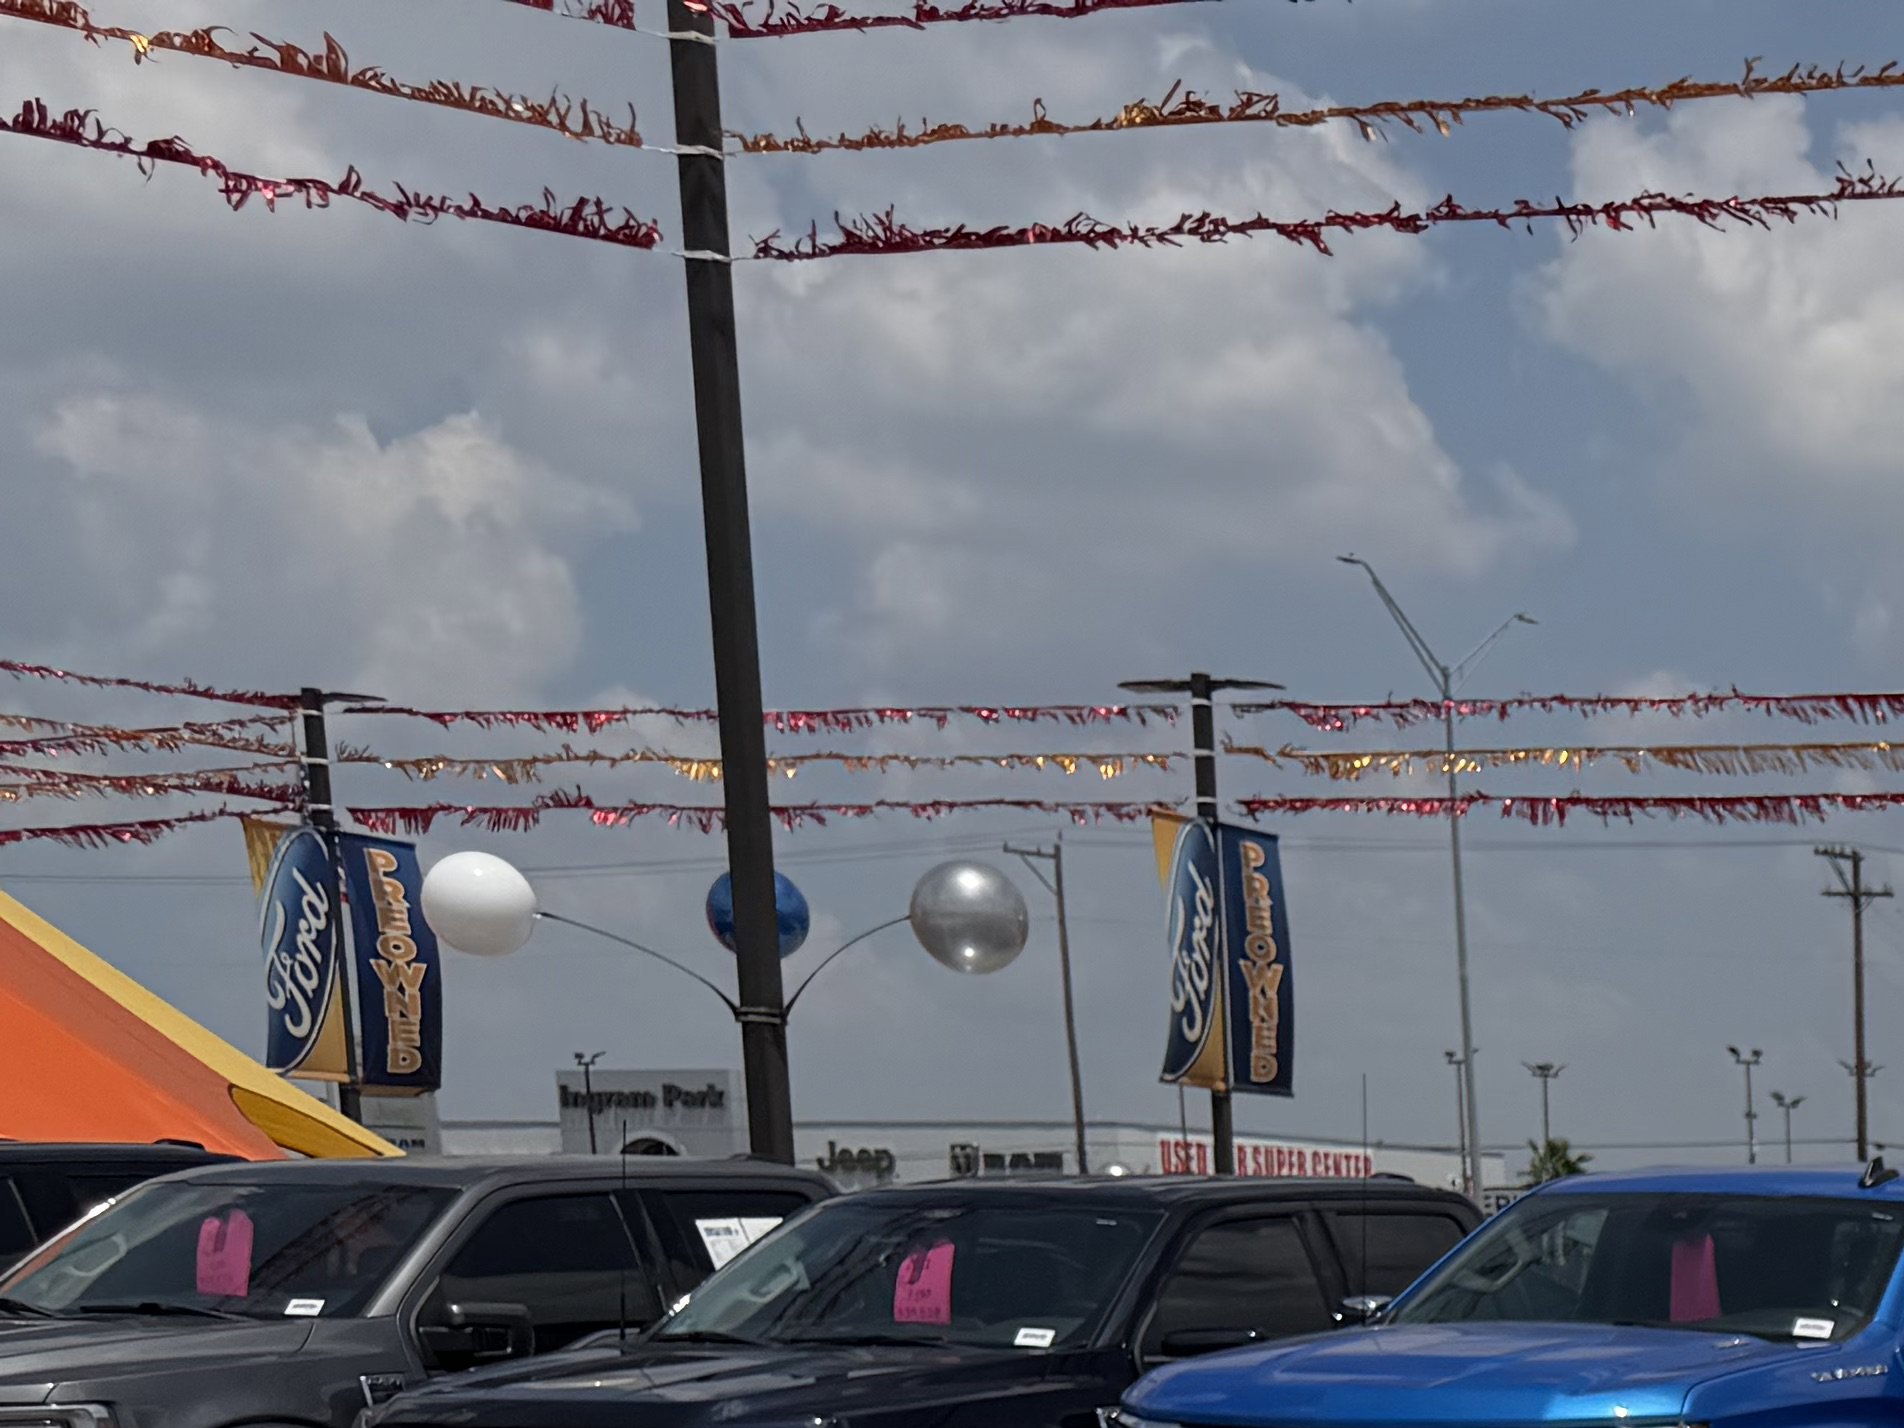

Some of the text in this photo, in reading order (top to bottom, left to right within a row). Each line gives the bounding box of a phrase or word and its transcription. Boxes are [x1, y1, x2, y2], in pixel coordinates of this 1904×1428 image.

[264, 867, 330, 1039] Ford
[363, 847, 428, 1075] PREOWNED
[1171, 859, 1214, 1043] Ford
[1239, 840, 1284, 1084] PREOWNED
[559, 1084, 724, 1115] Ingram Park
[816, 1141, 896, 1178] Jeep
[1160, 1140, 1207, 1176] USED
[1252, 1145, 1307, 1178] SUPER
[1312, 1151, 1373, 1179] CENTER
